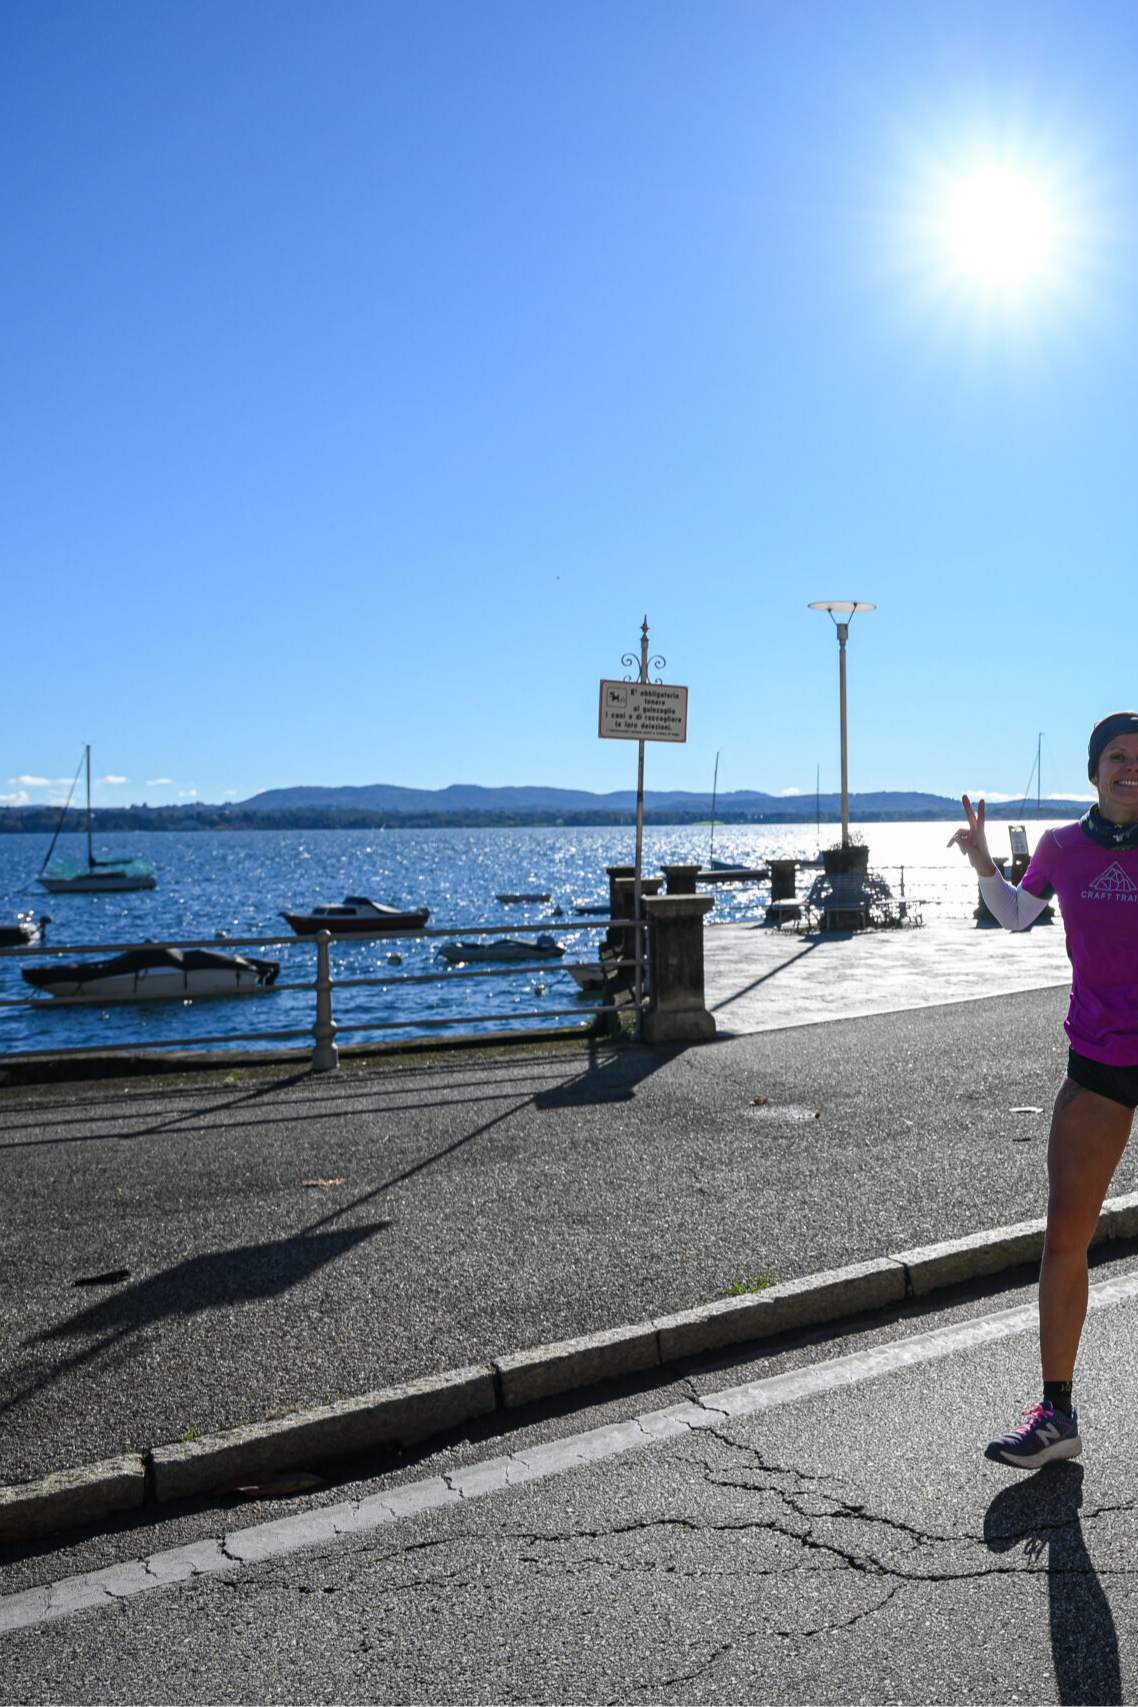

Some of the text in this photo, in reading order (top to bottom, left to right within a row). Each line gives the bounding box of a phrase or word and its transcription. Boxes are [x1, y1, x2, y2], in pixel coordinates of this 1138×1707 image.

[640, 690, 680, 699] obbligatorio
[644, 698, 666, 706] tenere
[642, 706, 676, 715] guinzaglio
[644, 714, 682, 723] raccogliere
[615, 720, 622, 728] le
[624, 721, 638, 729] loro
[1081, 890, 1112, 900] CRAFT
